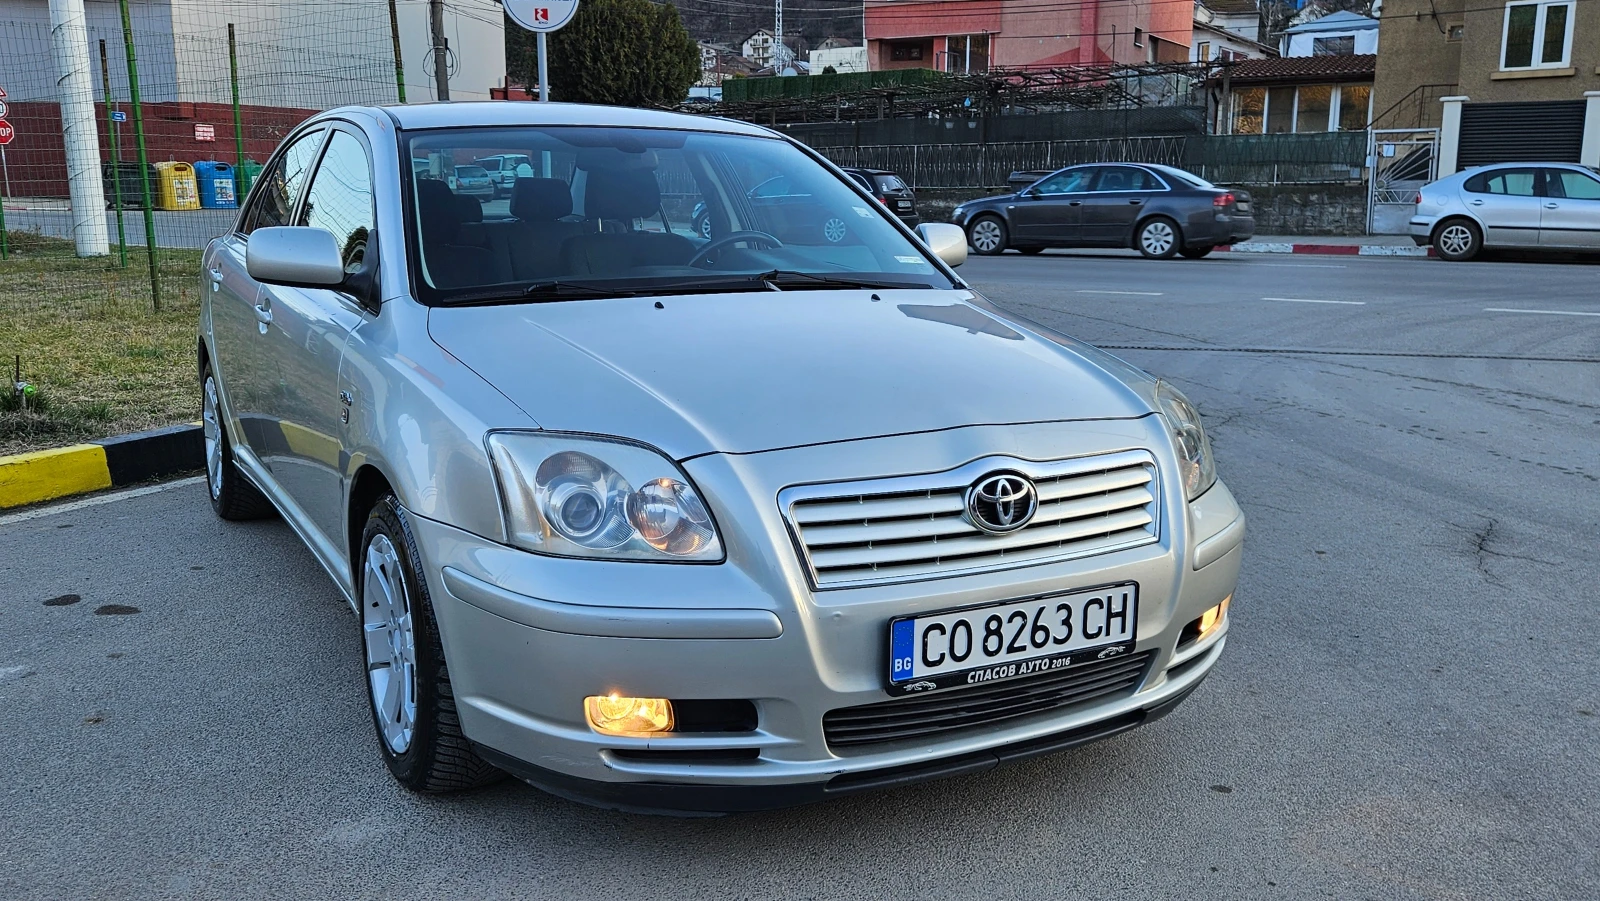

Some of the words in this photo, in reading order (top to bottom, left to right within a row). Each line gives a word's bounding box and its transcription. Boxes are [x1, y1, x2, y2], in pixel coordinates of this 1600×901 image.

[0, 127, 11, 136] OP
[922, 619, 973, 667] CO
[983, 602, 1073, 658] 8263
[1082, 592, 1128, 640] CH
[894, 657, 912, 673] BG
[967, 664, 1016, 684] СПАСОВ
[1018, 658, 1050, 675] АУТО
[1051, 656, 1071, 669] 2016
